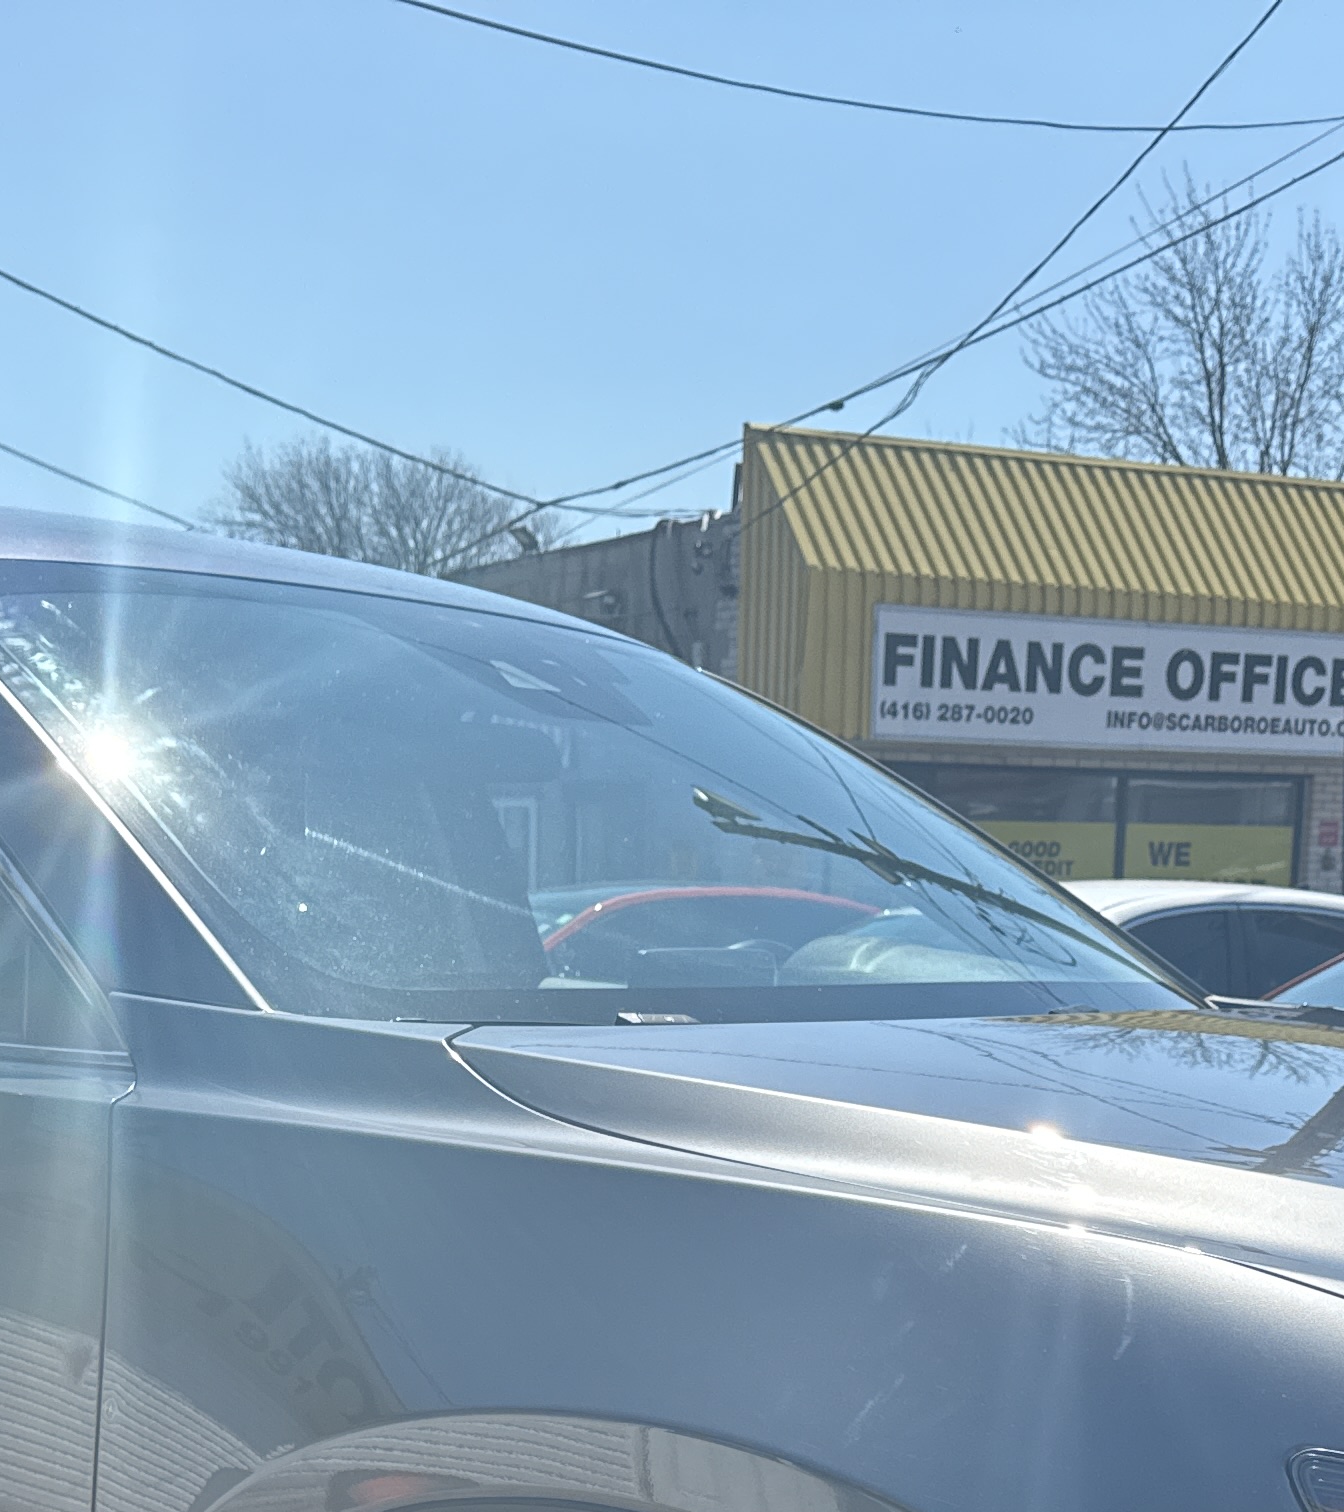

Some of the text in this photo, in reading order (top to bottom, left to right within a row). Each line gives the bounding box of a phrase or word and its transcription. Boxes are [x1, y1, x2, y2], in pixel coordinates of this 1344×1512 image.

[882, 631, 1145, 698] FINANCE
[880, 700, 1035, 725] (416) 287-0020
[1147, 841, 1192, 868] WE
